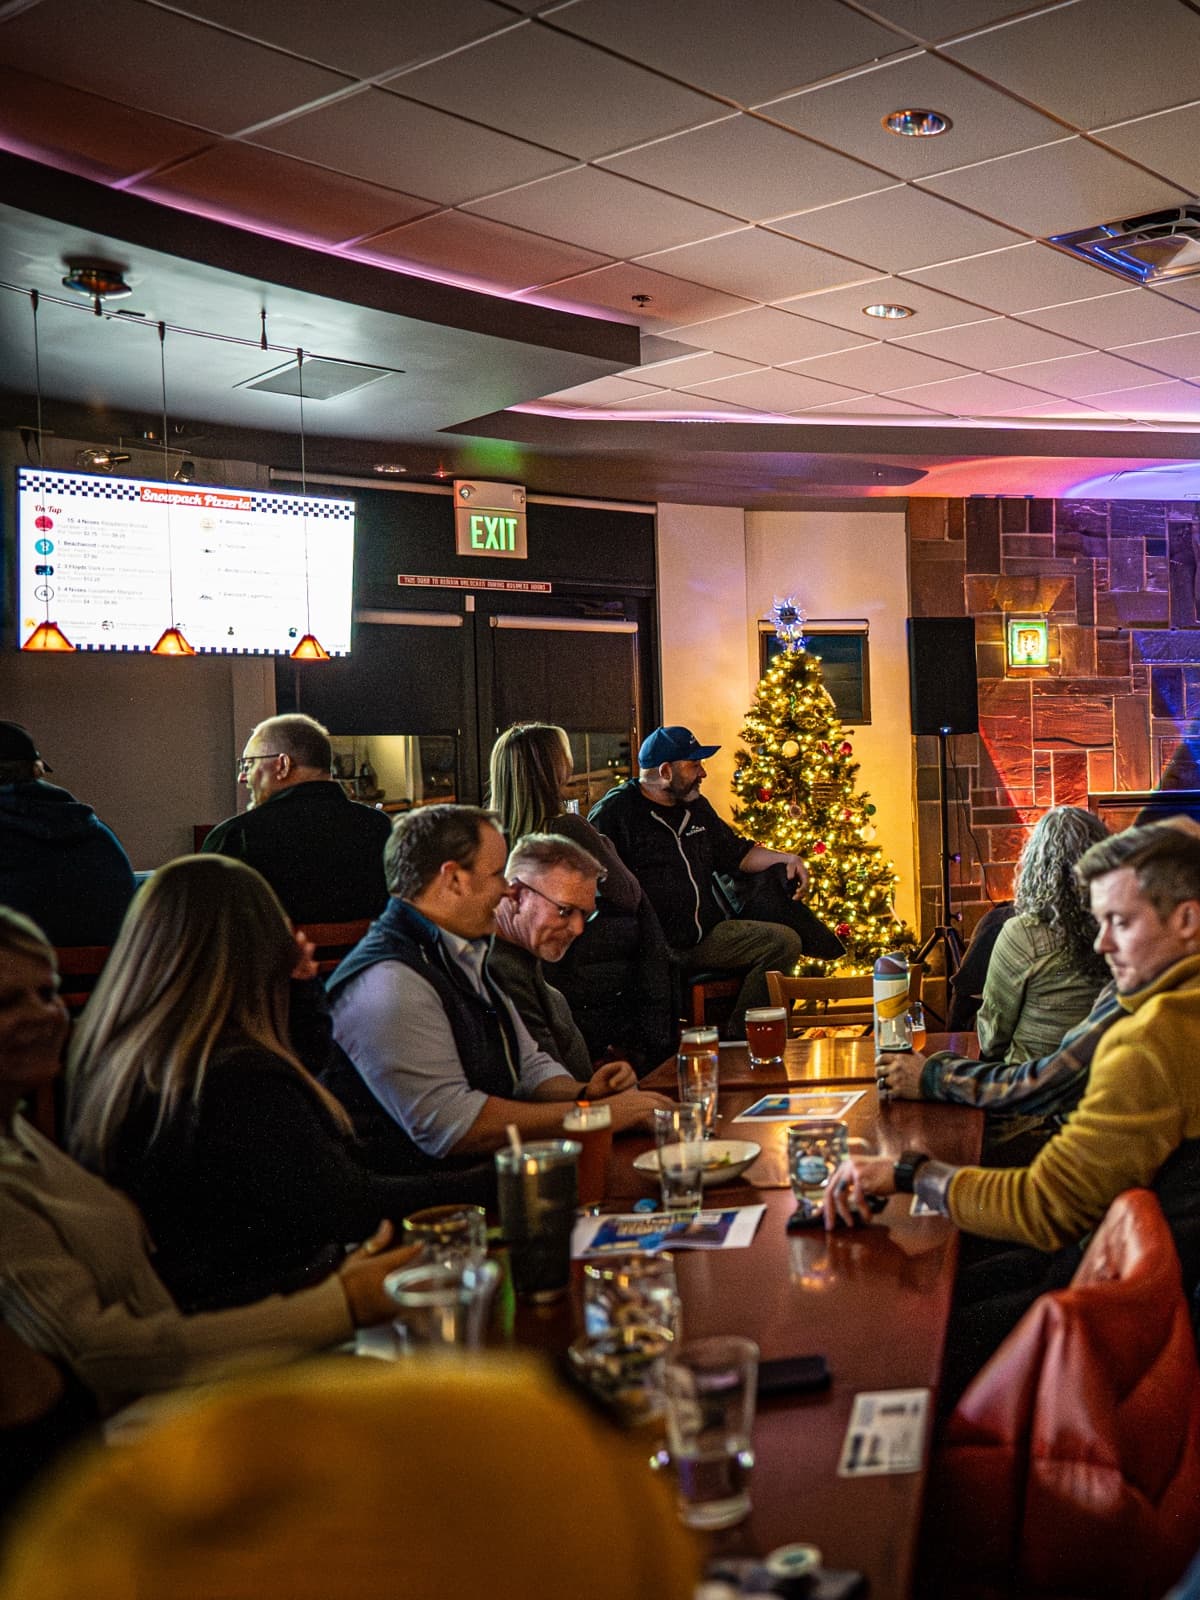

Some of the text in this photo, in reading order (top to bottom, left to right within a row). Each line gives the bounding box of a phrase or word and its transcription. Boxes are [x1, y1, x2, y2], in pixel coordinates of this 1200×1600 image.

[142, 488, 251, 509] Snowpack Pizzeria
[470, 514, 518, 551] EXIT
